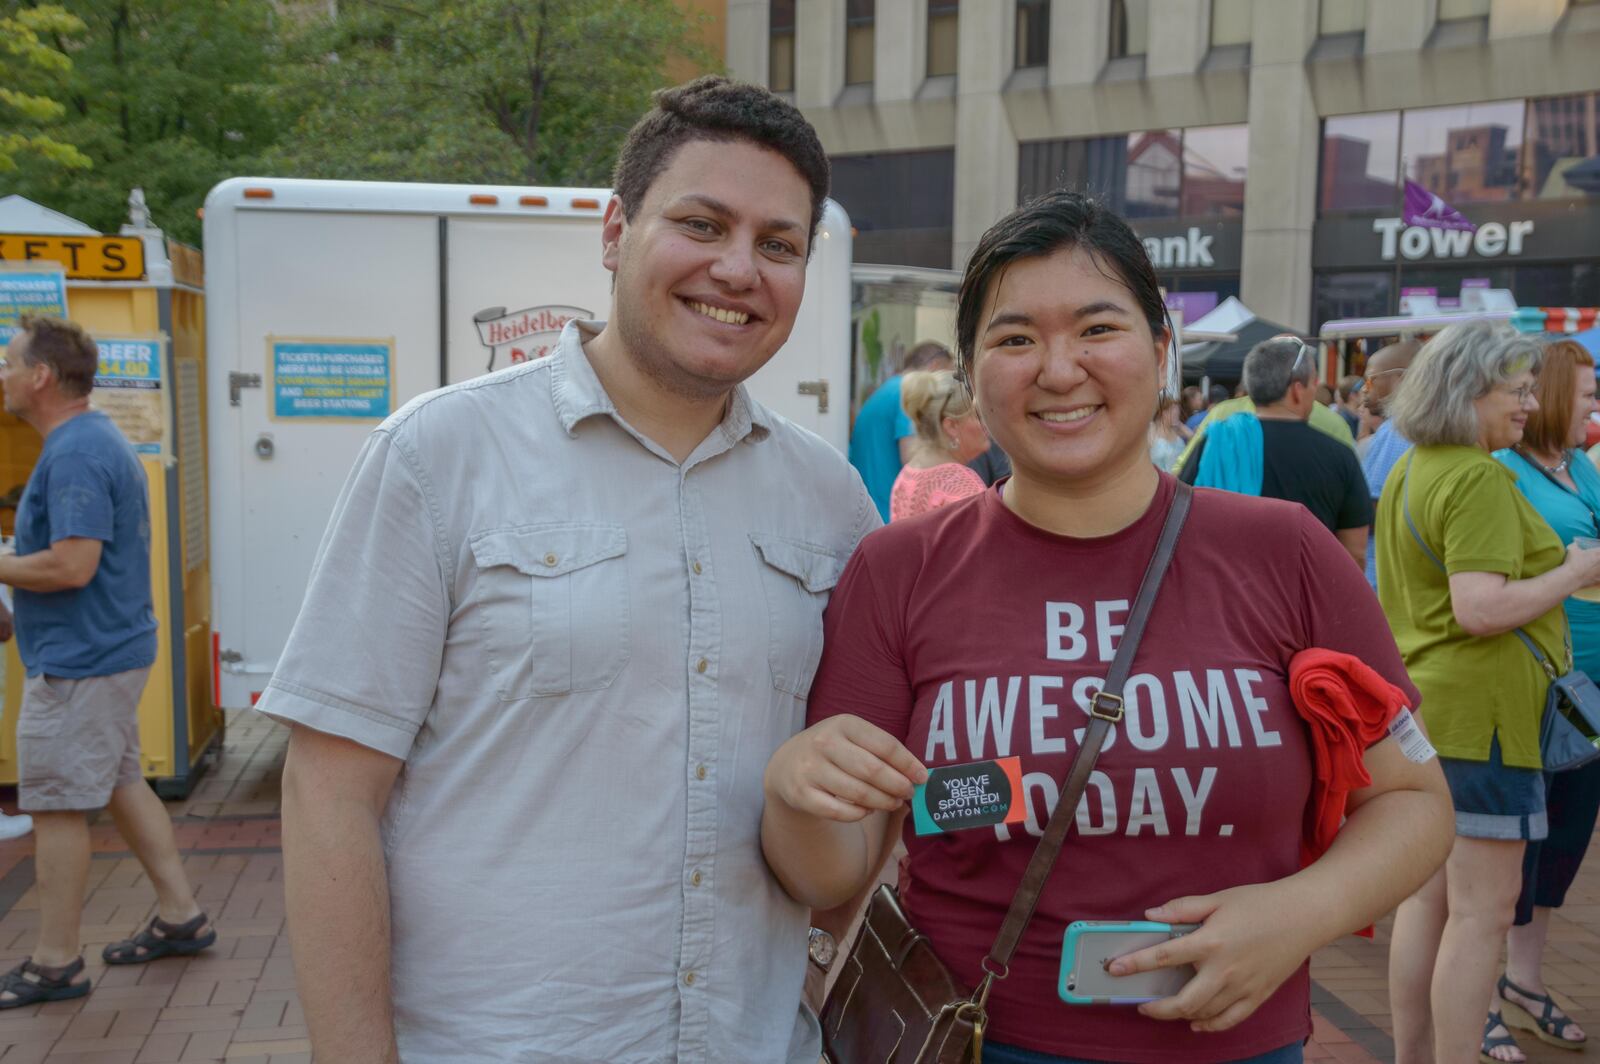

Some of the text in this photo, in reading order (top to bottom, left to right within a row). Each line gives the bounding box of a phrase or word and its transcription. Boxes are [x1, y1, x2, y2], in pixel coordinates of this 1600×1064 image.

[1373, 218, 1534, 260] Tower
[0, 239, 127, 273] ETS
[487, 309, 574, 343] Heidelbe
[96, 343, 153, 361] BEER
[279, 352, 385, 364] TICKETS PURCHASED
[278, 364, 305, 374] HERE
[307, 364, 328, 374] MAY
[330, 364, 343, 374] BE
[345, 365, 372, 375] USED
[280, 387, 303, 397] AND
[293, 398, 371, 410] BEER STATIONS
[1045, 599, 1130, 662] BE
[924, 668, 1283, 761] AWESOME
[943, 774, 990, 790] YOU'VE
[938, 792, 1000, 810] SPOTTED!
[951, 785, 985, 799] BEEN
[994, 766, 1235, 841] ODAY.
